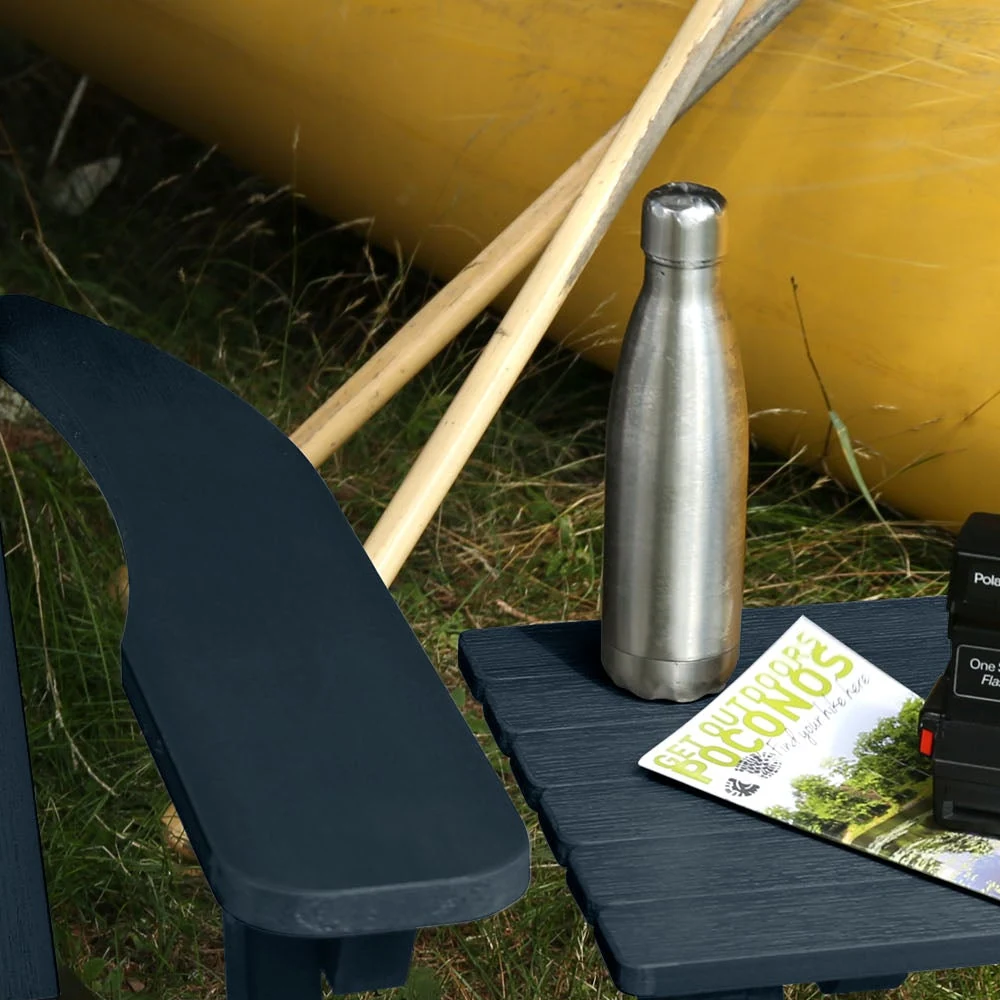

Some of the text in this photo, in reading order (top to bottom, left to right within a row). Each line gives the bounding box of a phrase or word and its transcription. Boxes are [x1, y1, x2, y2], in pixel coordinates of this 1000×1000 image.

[653, 631, 821, 770] GET OUTDOORS
[969, 658, 996, 671] One
[670, 641, 854, 785] POCONOS
[798, 715, 823, 747] your
